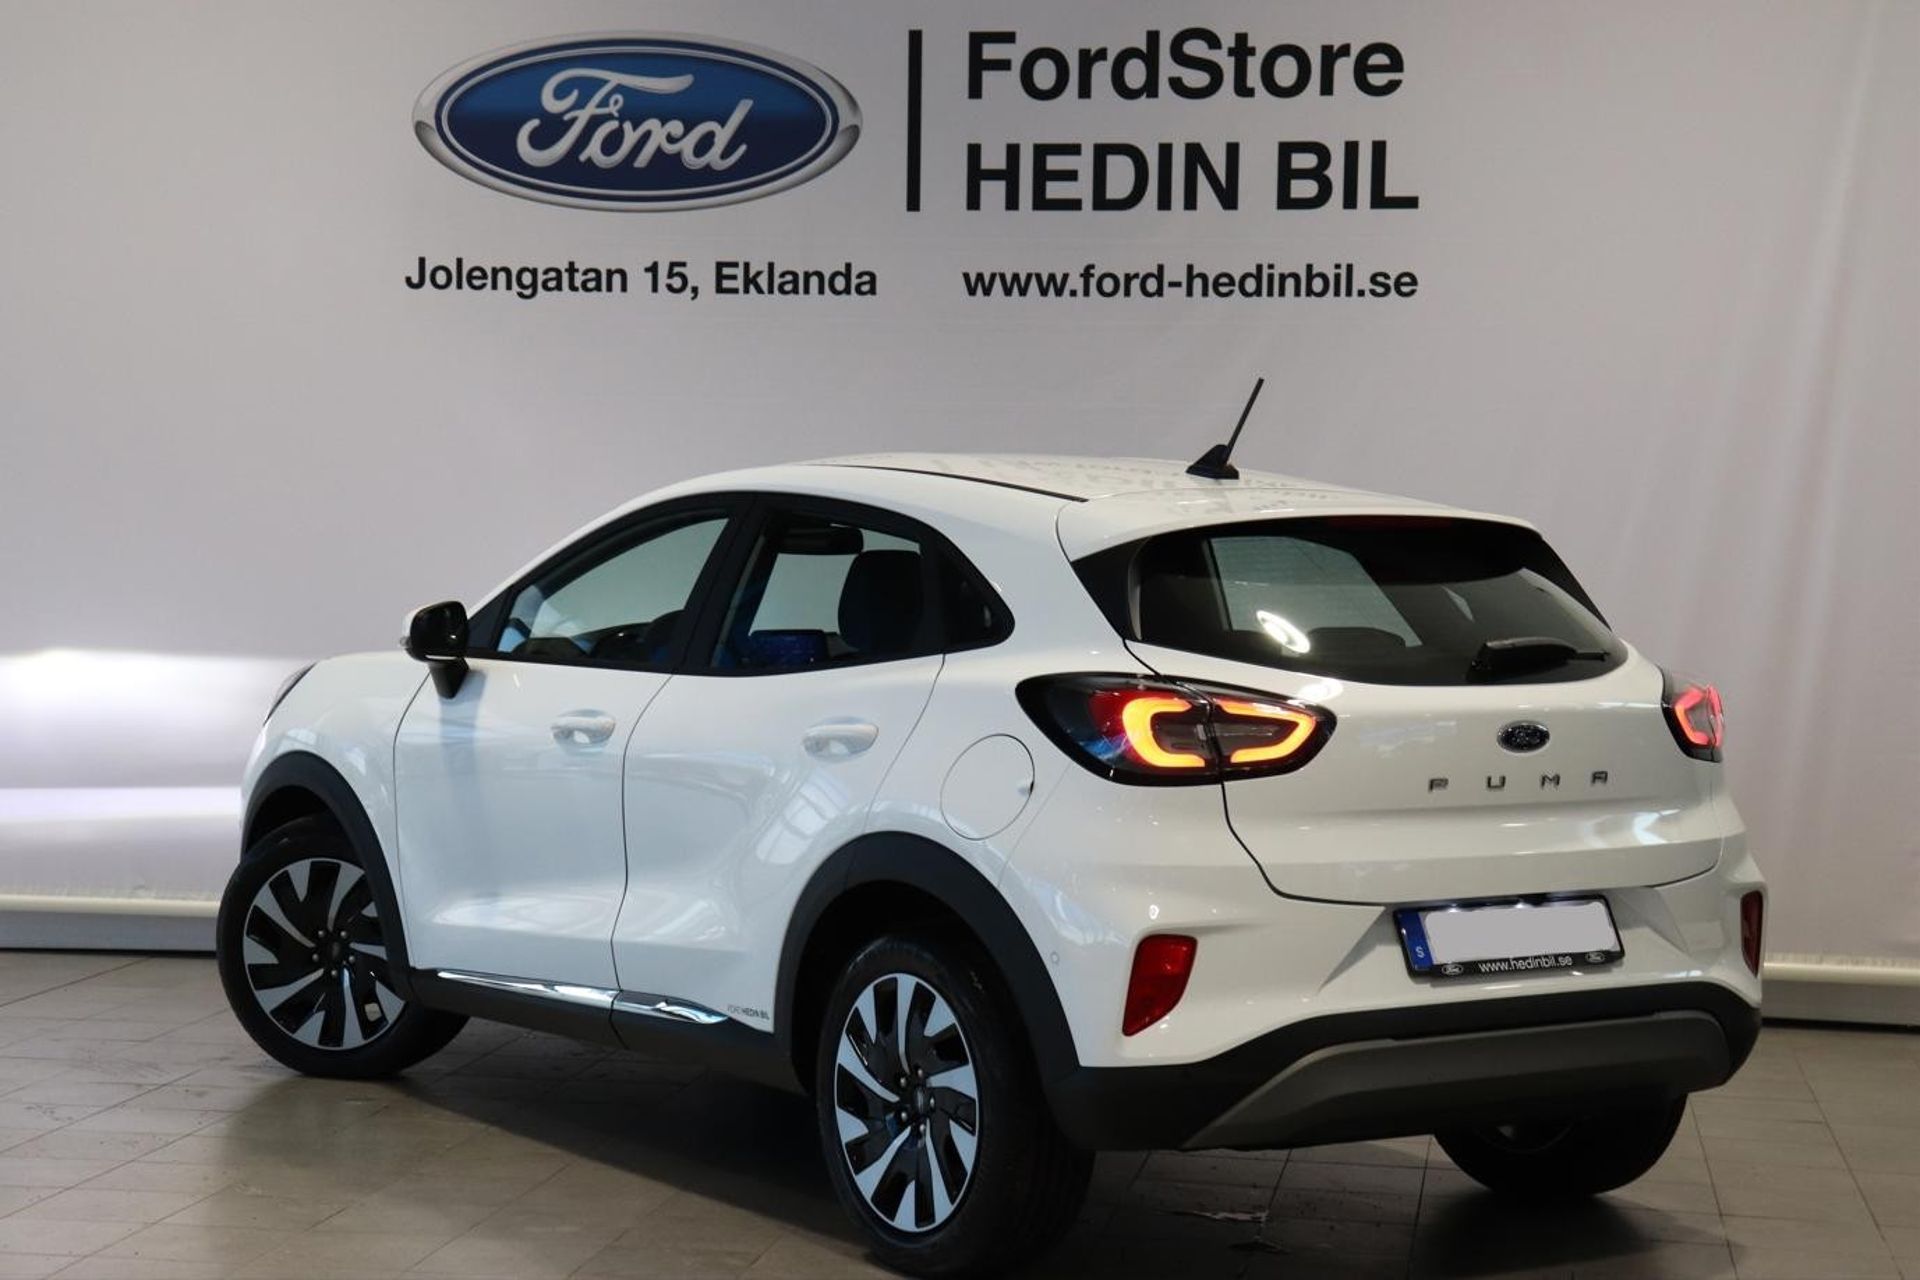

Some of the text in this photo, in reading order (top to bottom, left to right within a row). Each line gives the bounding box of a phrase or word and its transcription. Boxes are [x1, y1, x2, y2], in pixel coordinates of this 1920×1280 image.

[967, 26, 1405, 102] FordStore
[516, 67, 754, 171] Ford
[965, 139, 1420, 212] HEDIN BIL
[404, 256, 878, 301] Jolengatan 15, Eklanda
[961, 262, 1419, 299] www.ford-hedinbil.se
[1428, 770, 1609, 793] PUMA
[1415, 946, 1425, 959] S
[1477, 954, 1574, 973] www.hedinbil.se
